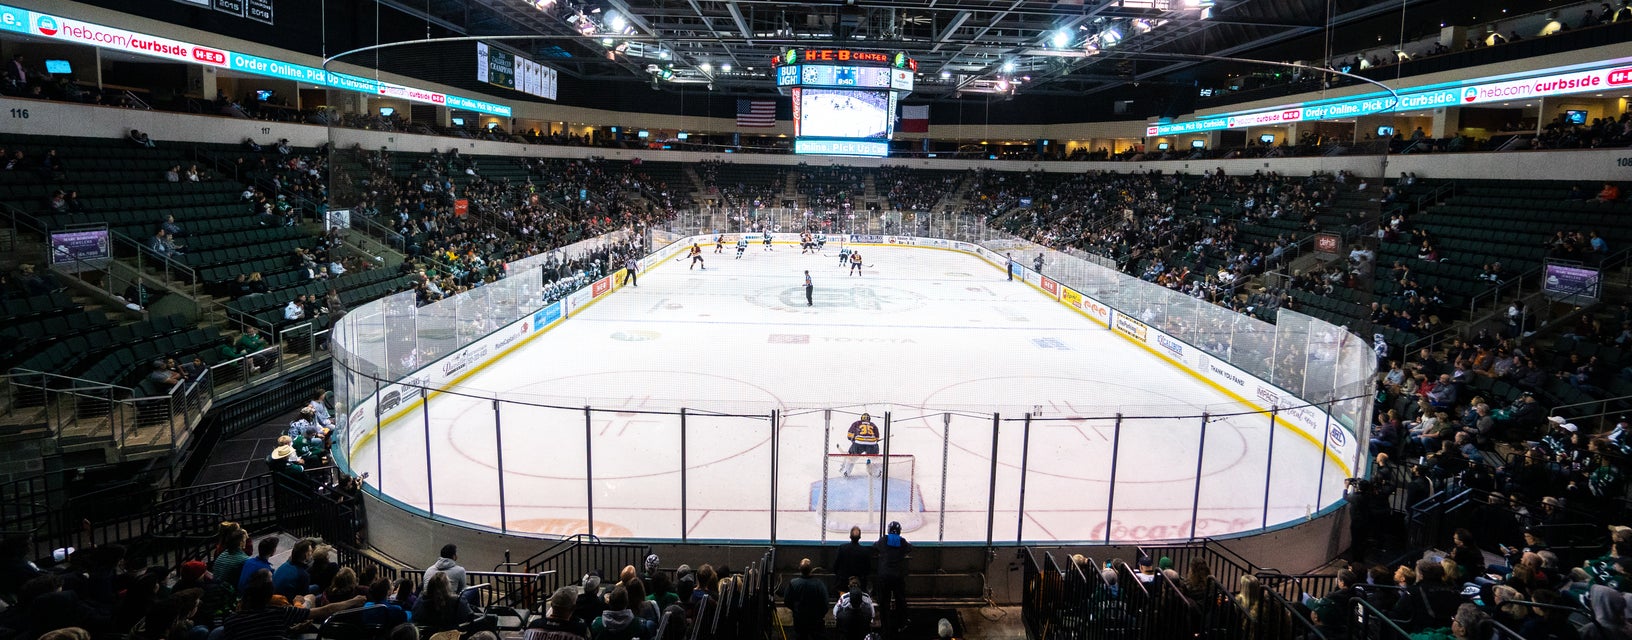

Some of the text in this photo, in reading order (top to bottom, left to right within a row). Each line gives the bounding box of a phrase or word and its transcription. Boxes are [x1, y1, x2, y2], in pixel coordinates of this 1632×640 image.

[62, 22, 187, 57] heb.com/curbside
[853, 52, 887, 62] CENTER
[235, 56, 267, 71] Order
[270, 63, 305, 79] Online.
[307, 69, 326, 81] Pick
[327, 74, 338, 85] Up
[781, 66, 797, 76] BUD
[780, 75, 798, 86] LIGHT
[1480, 74, 1600, 98] heb.com/curbside
[1305, 107, 1328, 117] Order
[1330, 104, 1360, 114] Online.
[1362, 99, 1382, 110] Pick
[1401, 92, 1456, 107] Curbside.
[10, 108, 29, 119] 116
[261, 127, 270, 135] 117
[1211, 364, 1223, 376] THANK
[1224, 372, 1232, 380] YOU
[858, 424, 875, 437] 35
